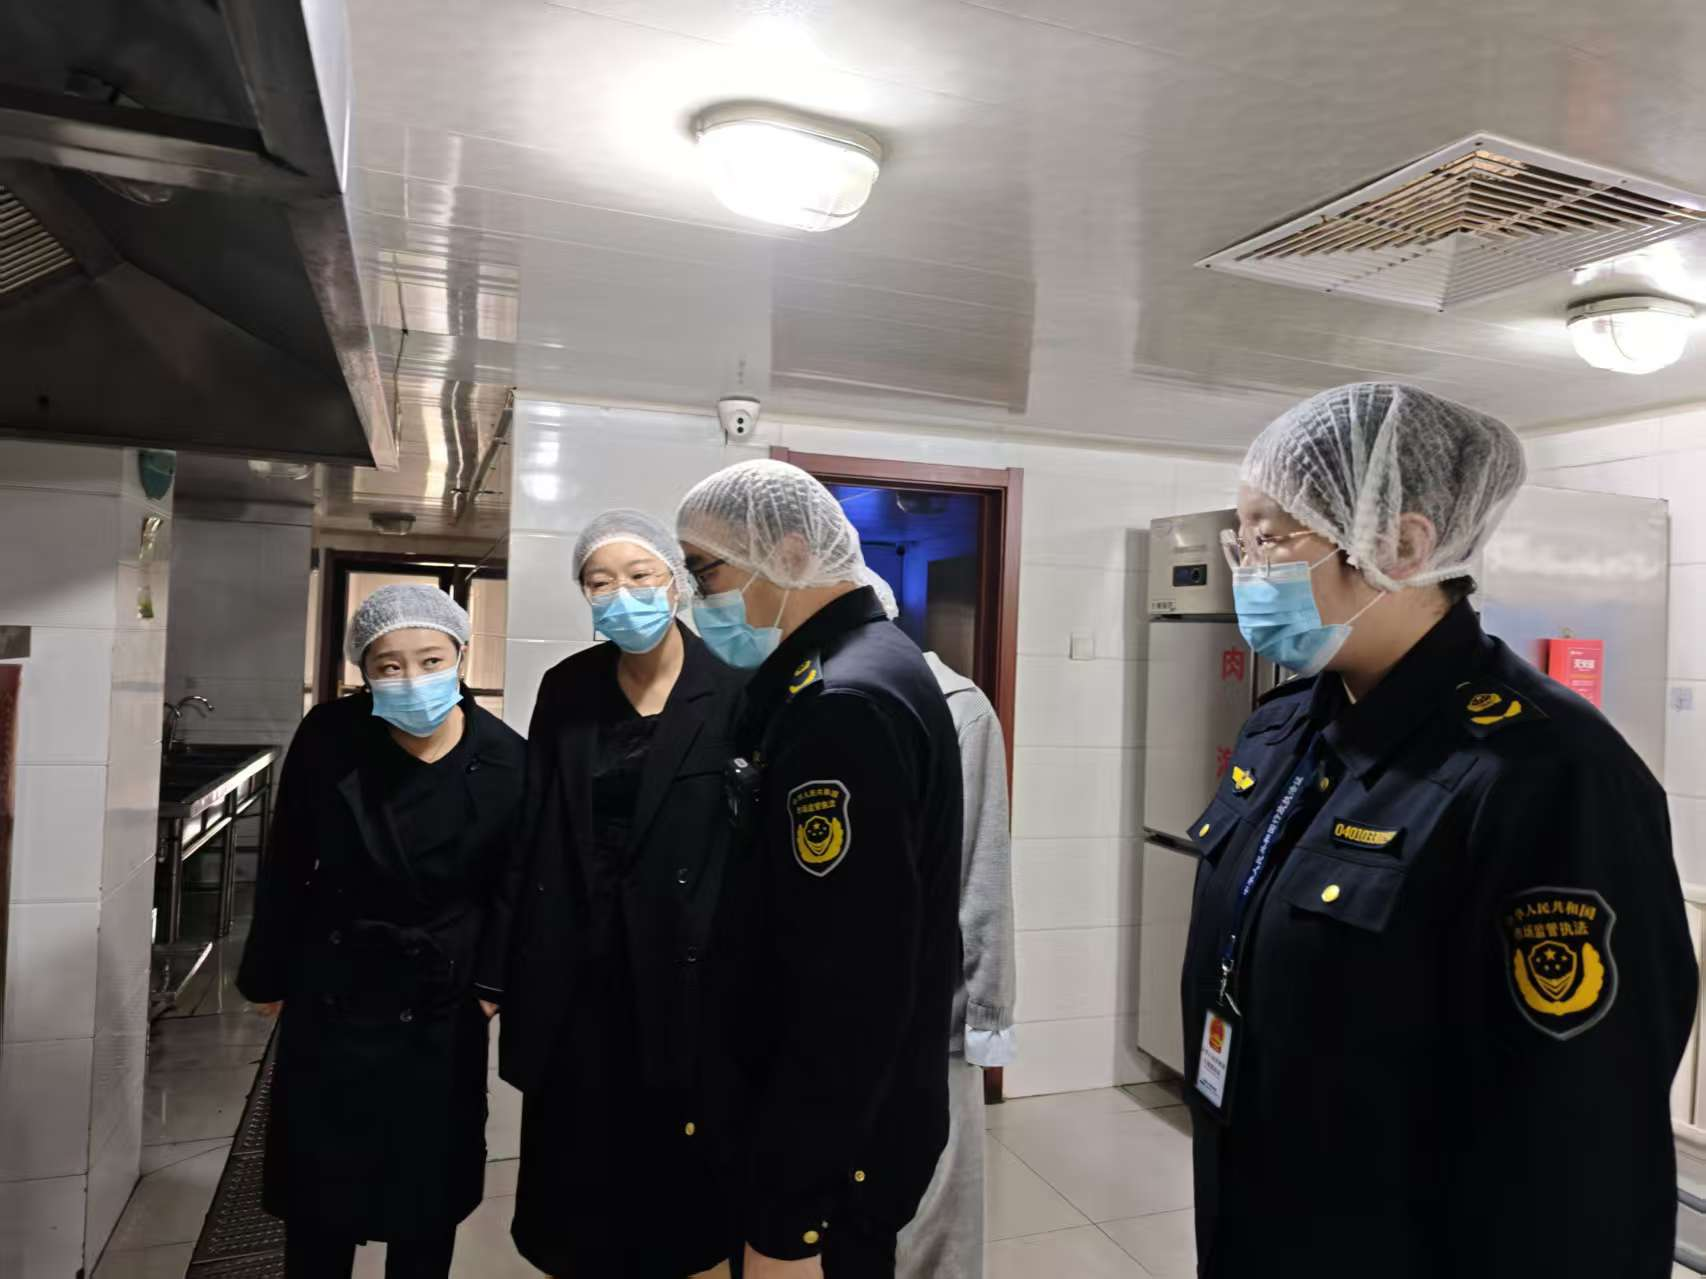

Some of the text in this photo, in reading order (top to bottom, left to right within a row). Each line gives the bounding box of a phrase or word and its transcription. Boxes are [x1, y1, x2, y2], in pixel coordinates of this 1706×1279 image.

[1222, 649, 1244, 681] 肉
[1507, 900, 1596, 923] 华人民共和国
